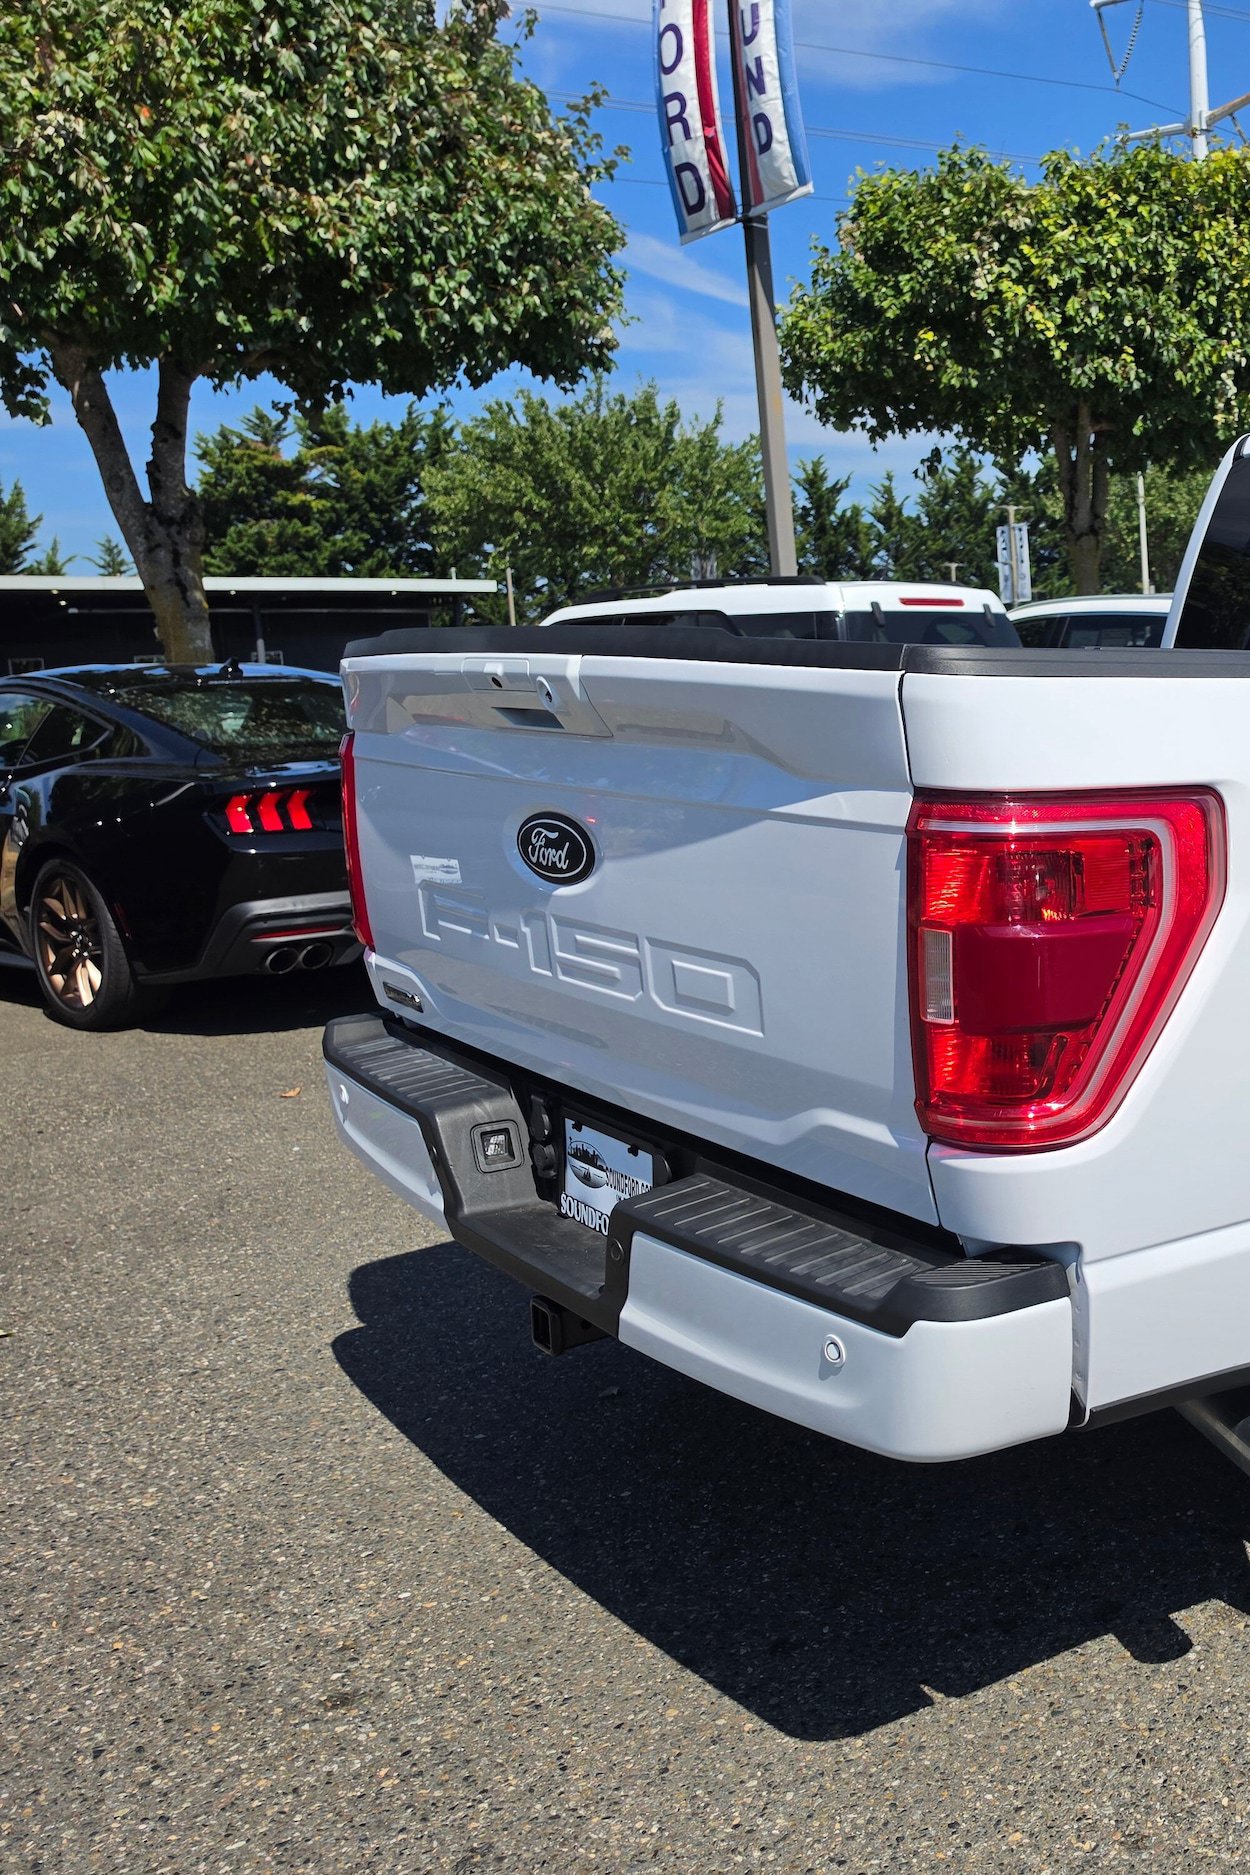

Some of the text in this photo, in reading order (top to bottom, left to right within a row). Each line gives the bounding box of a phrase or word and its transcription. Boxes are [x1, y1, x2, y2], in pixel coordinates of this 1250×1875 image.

[660, 0, 706, 216] ORD
[528, 826, 571, 871] Ford
[417, 880, 765, 1038] F-150
